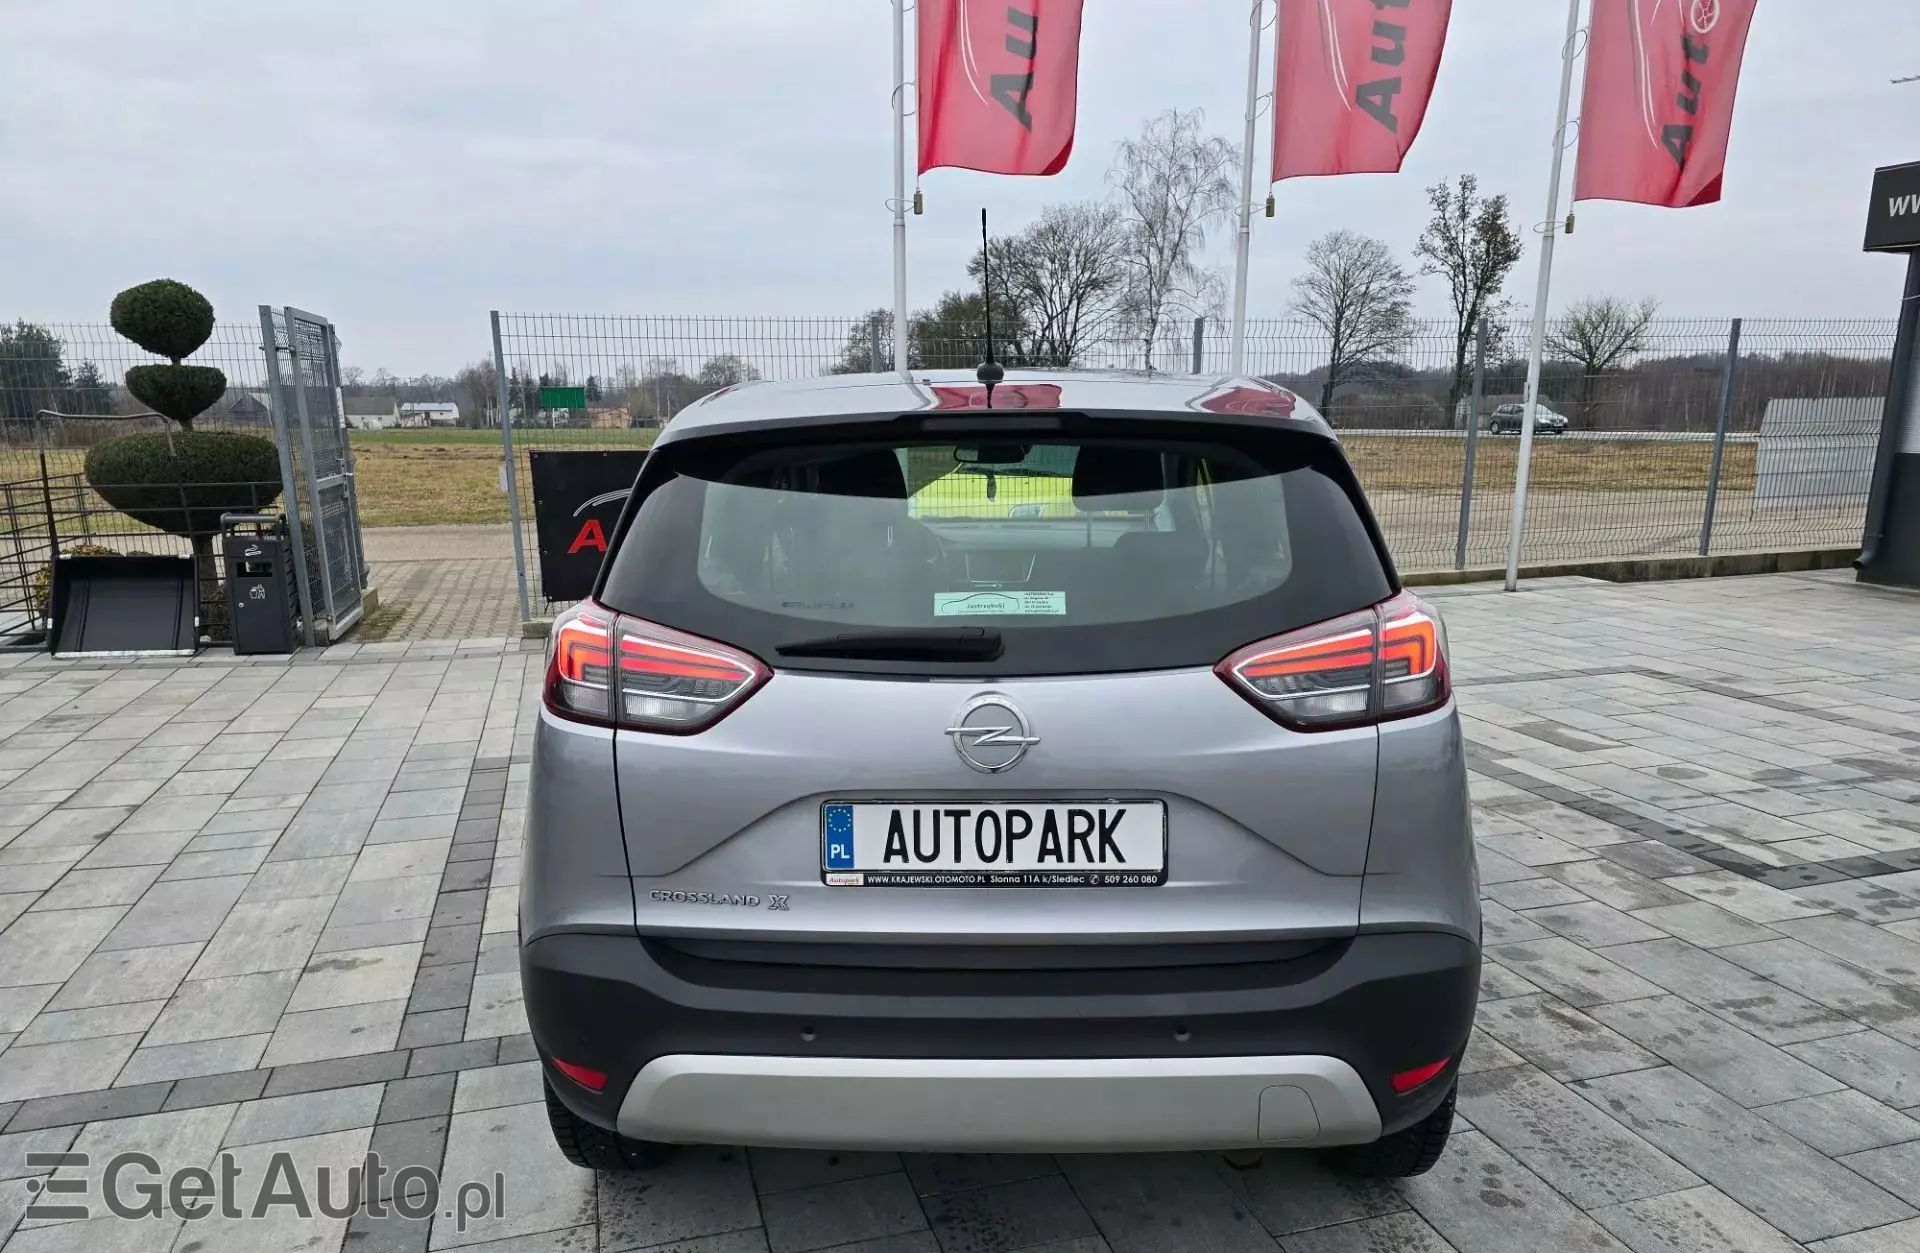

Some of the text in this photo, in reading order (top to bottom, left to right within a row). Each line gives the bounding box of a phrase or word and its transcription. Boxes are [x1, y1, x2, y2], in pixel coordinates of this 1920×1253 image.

[883, 809, 1127, 864] AUTOPARK
[831, 844, 850, 859] PL
[1024, 875, 1041, 883] 11A
[1104, 875, 1120, 884] 509
[1122, 875, 1139, 884] 260
[1140, 875, 1158, 884] 080
[648, 889, 790, 911] CROSSLAND X
